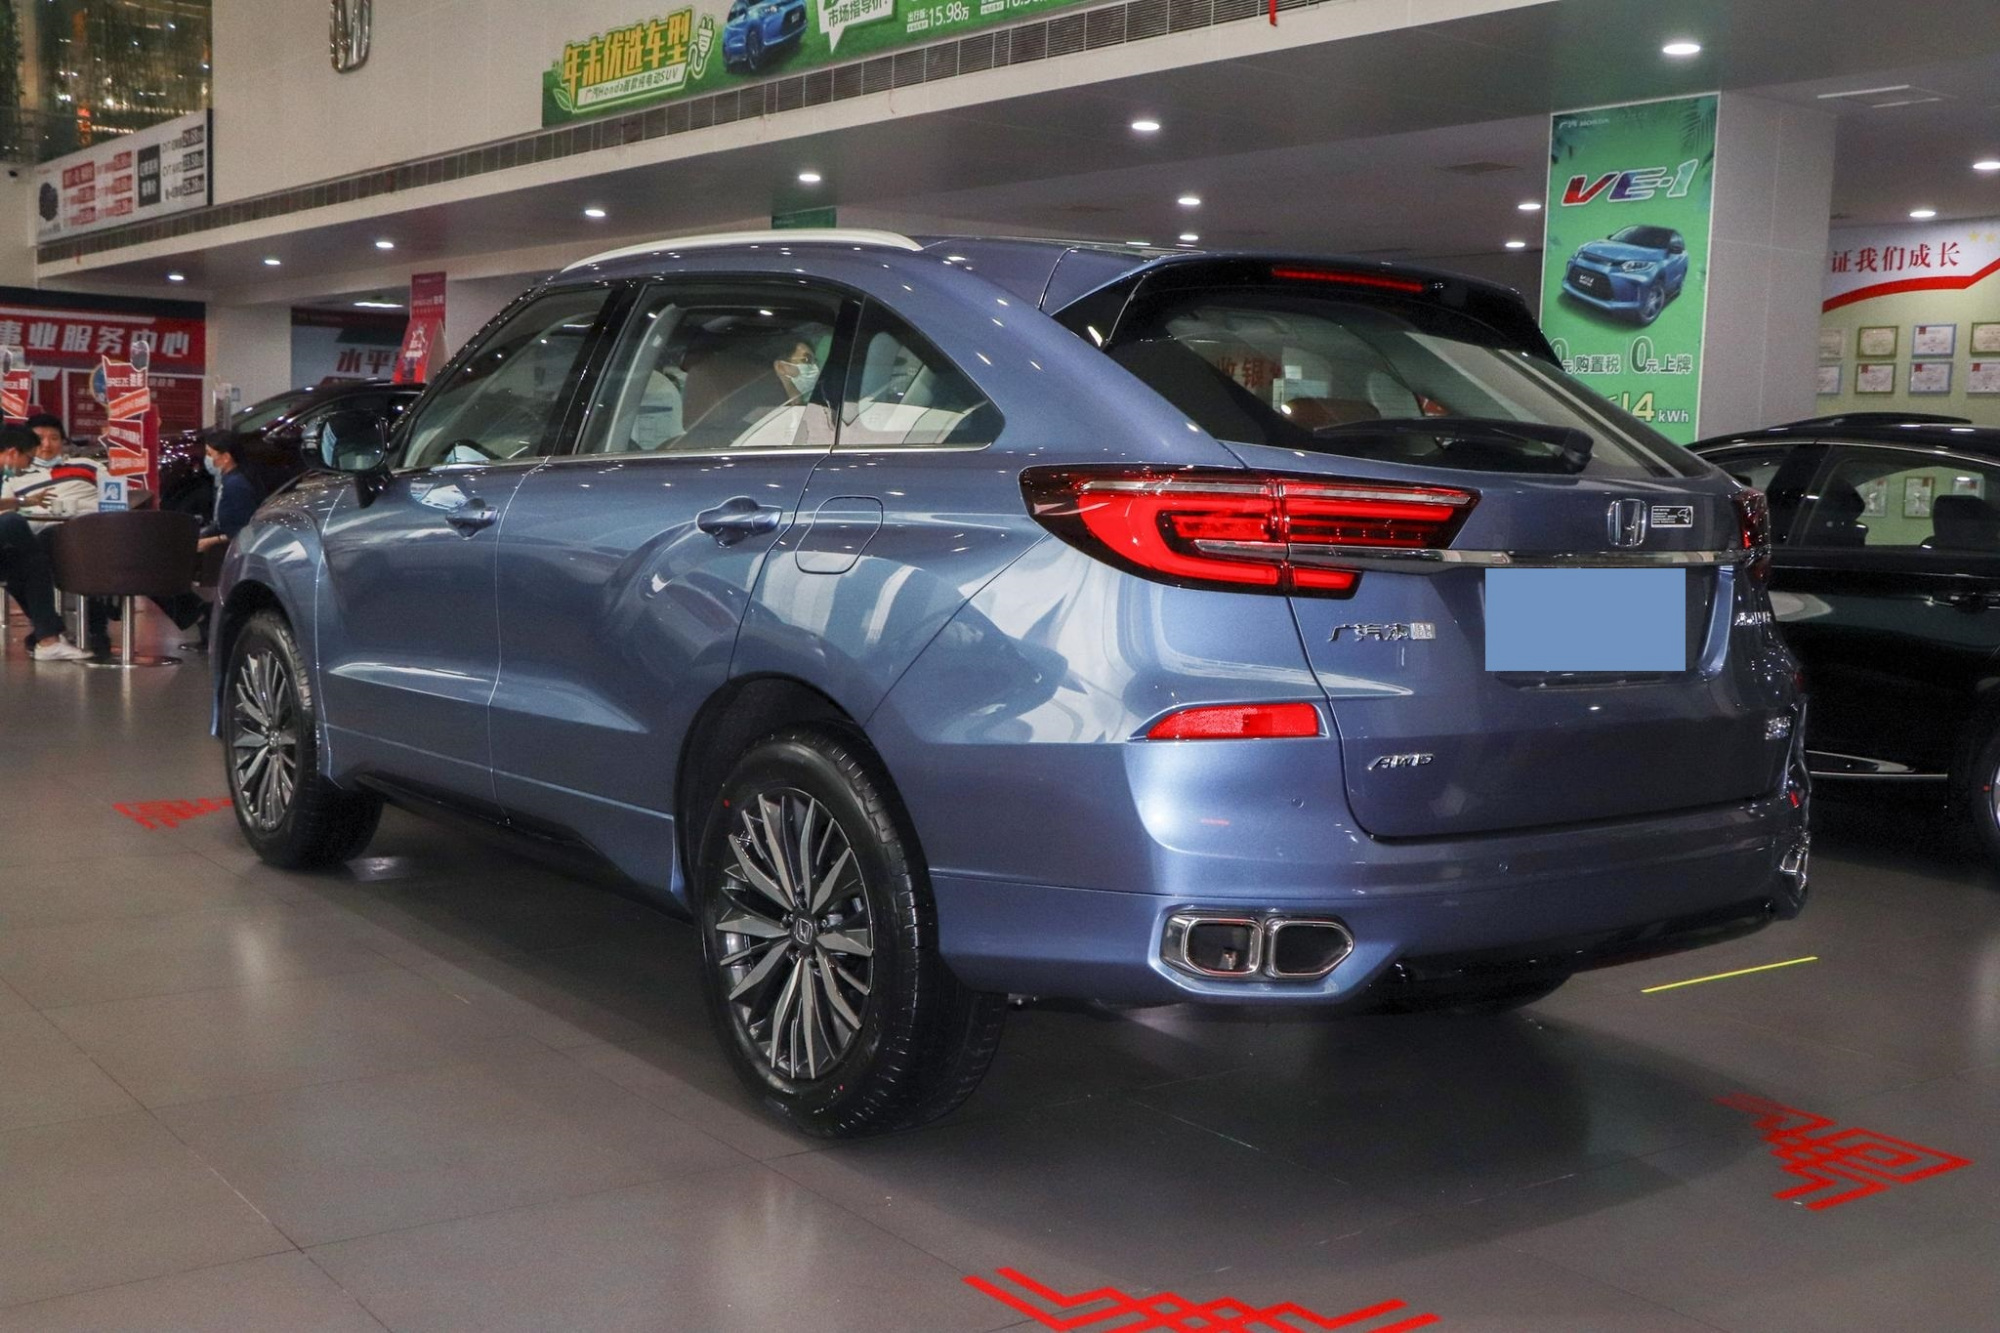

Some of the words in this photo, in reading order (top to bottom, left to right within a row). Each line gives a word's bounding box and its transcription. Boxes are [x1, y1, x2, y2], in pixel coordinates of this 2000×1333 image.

[563, 9, 692, 103] 年末优选车型
[336, 348, 402, 375] 水平
[1630, 335, 1693, 375] 0元上牌
[1658, 409, 1690, 423] kWh
